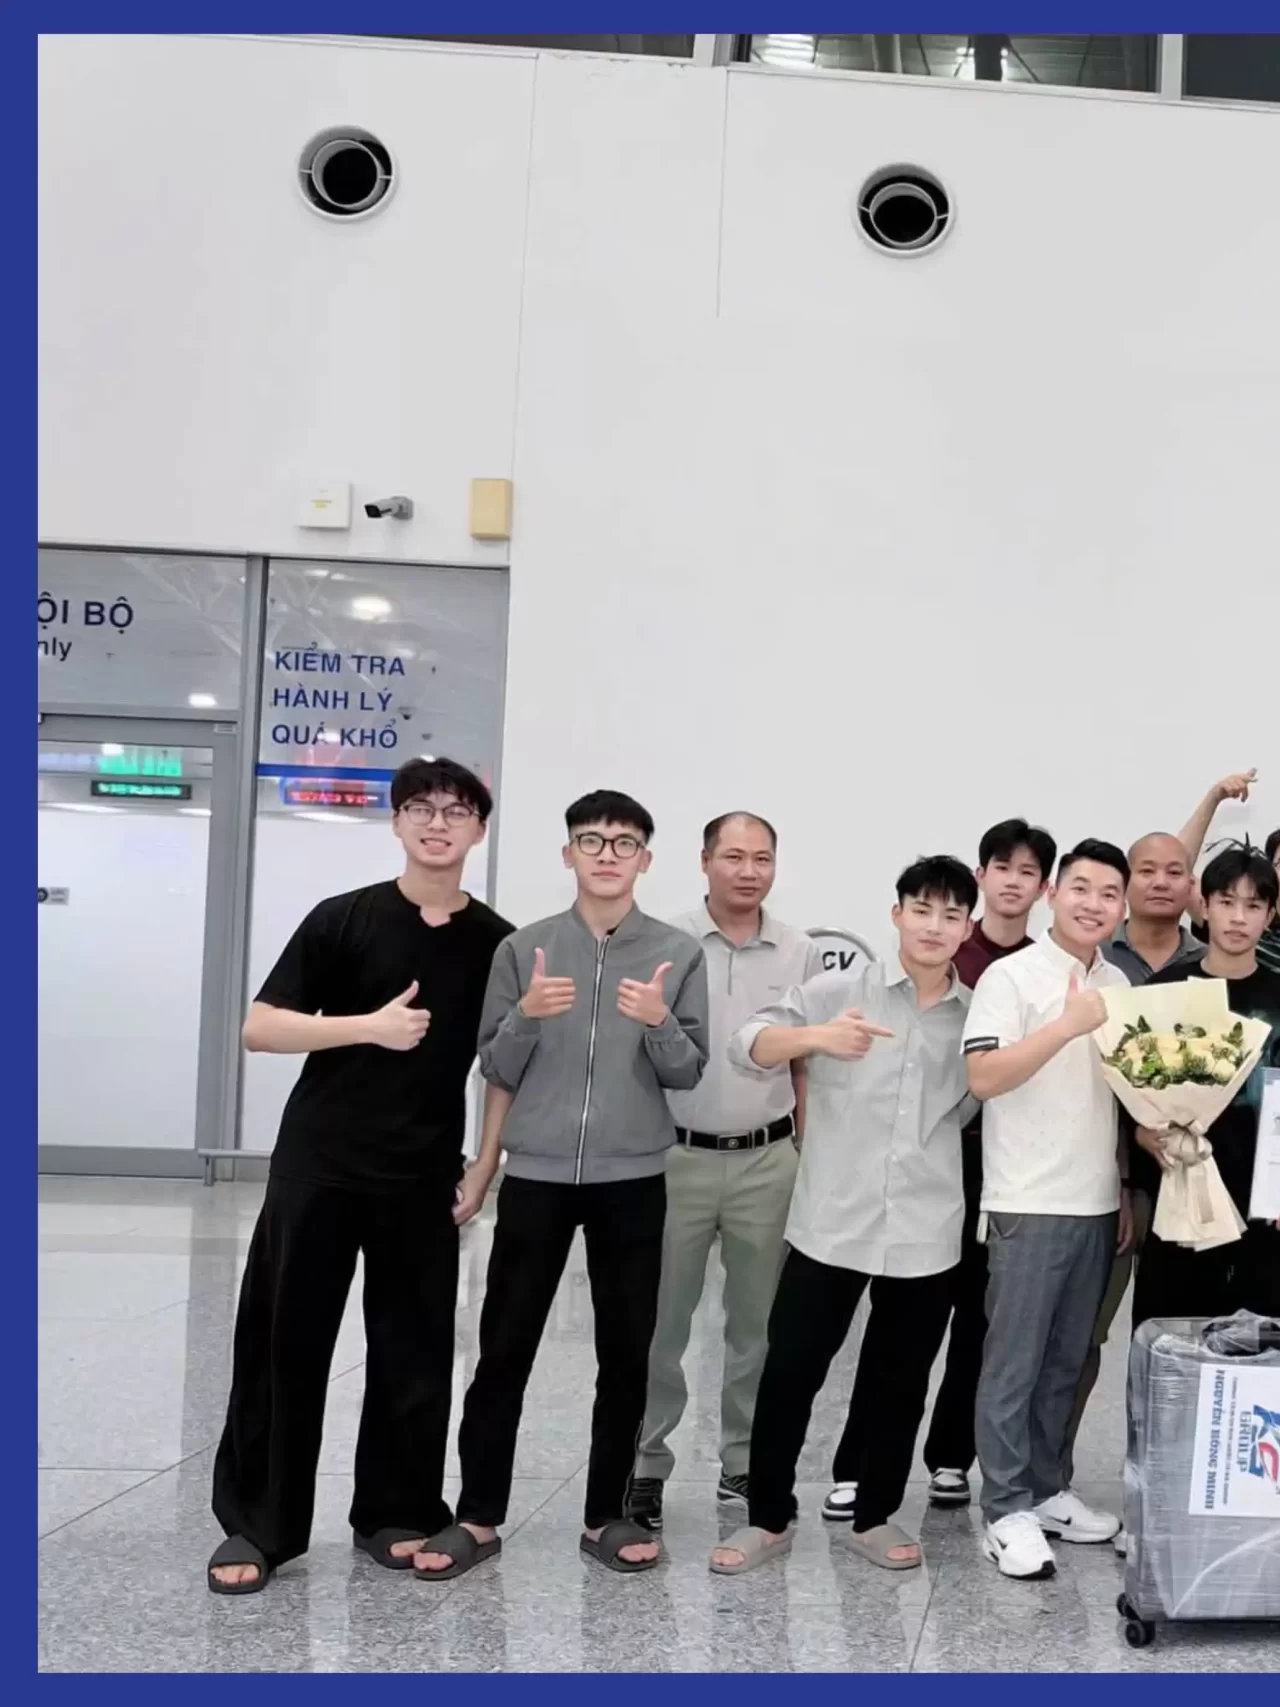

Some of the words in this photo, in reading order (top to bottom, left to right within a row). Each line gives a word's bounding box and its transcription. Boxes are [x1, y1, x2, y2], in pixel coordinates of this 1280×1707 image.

[84, 596, 134, 635] BỘ
[275, 641, 342, 673] KIỂM
[350, 654, 406, 676] TRA
[273, 682, 349, 710] HÀNH
[360, 687, 393, 712] LÝ
[340, 718, 398, 749] KHỔ
[1236, 1410, 1252, 1473] GROUP
